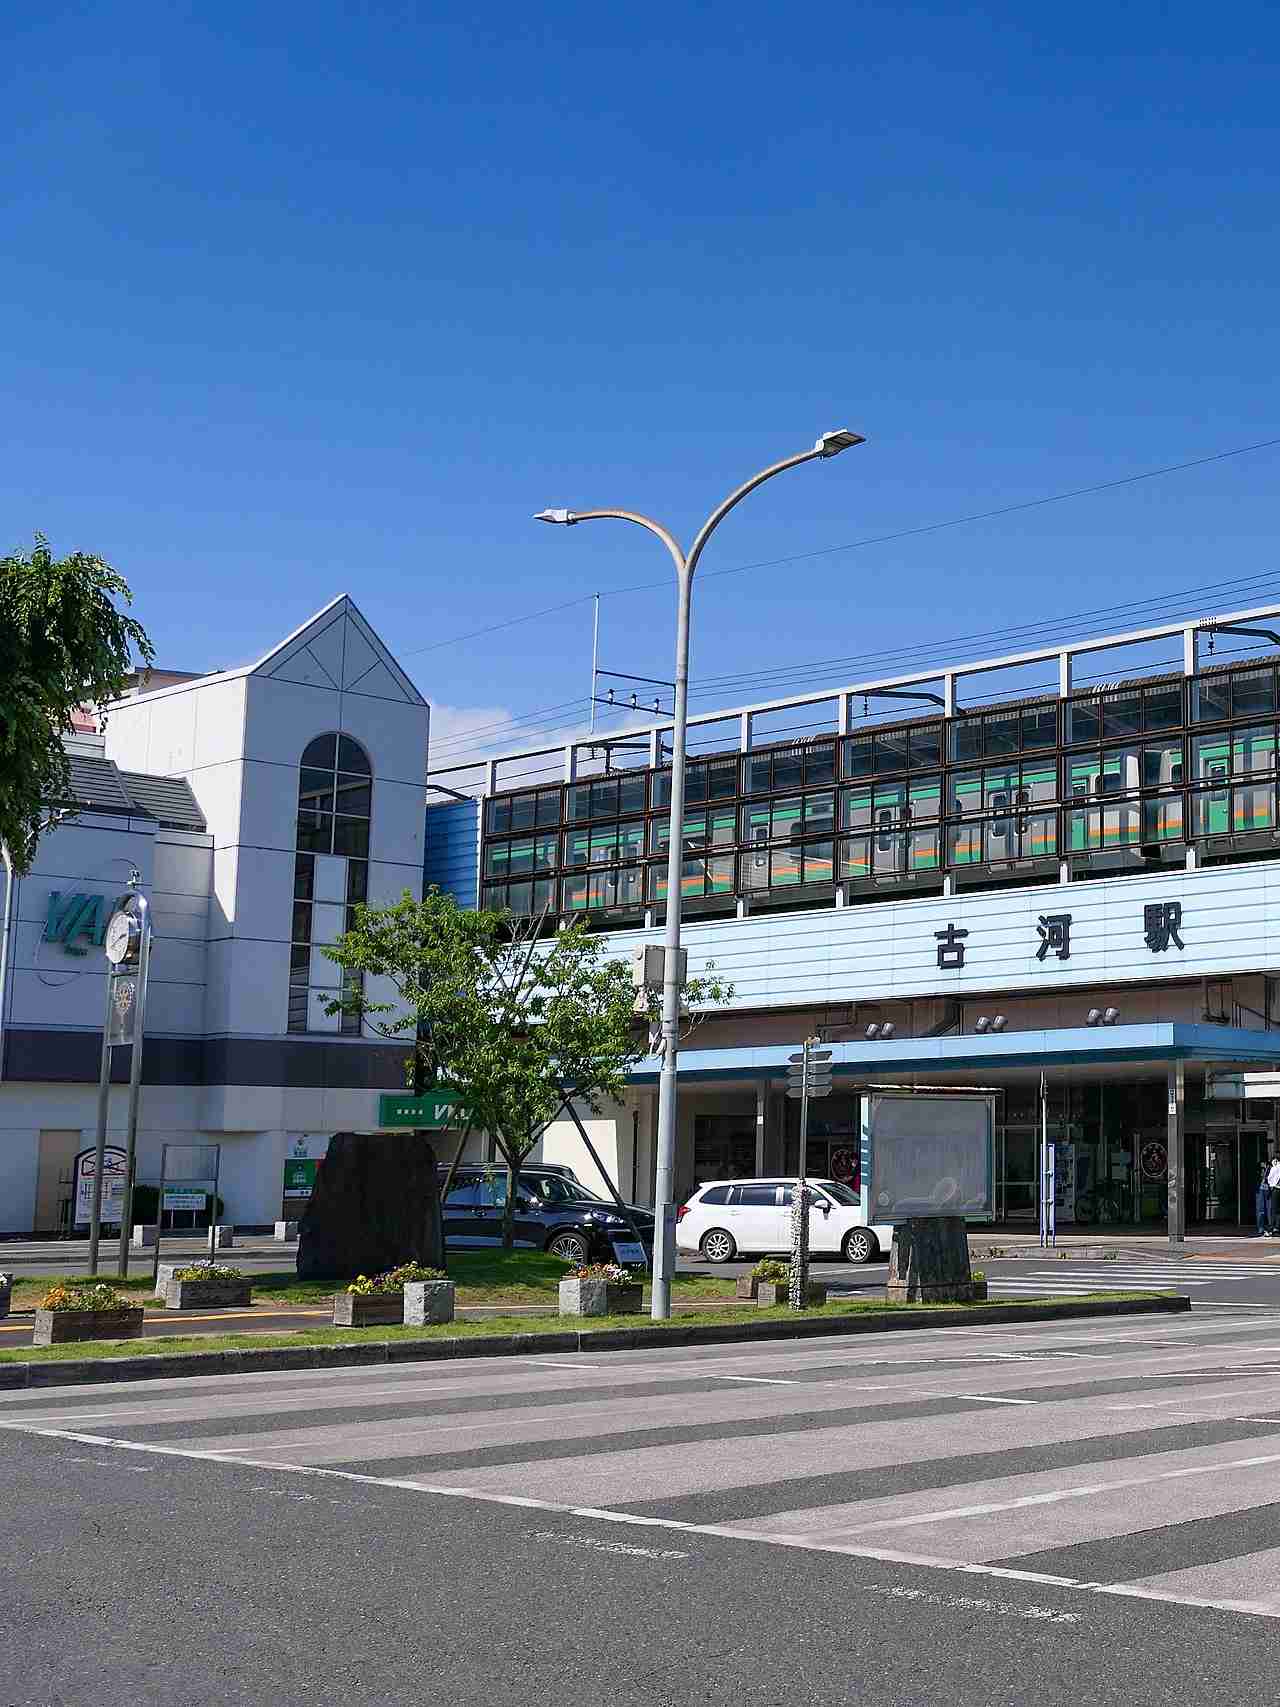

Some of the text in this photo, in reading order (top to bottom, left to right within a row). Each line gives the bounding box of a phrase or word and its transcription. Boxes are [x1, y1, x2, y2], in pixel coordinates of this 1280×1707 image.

[47, 891, 117, 946] VA
[934, 901, 1185, 970] 古河駅
